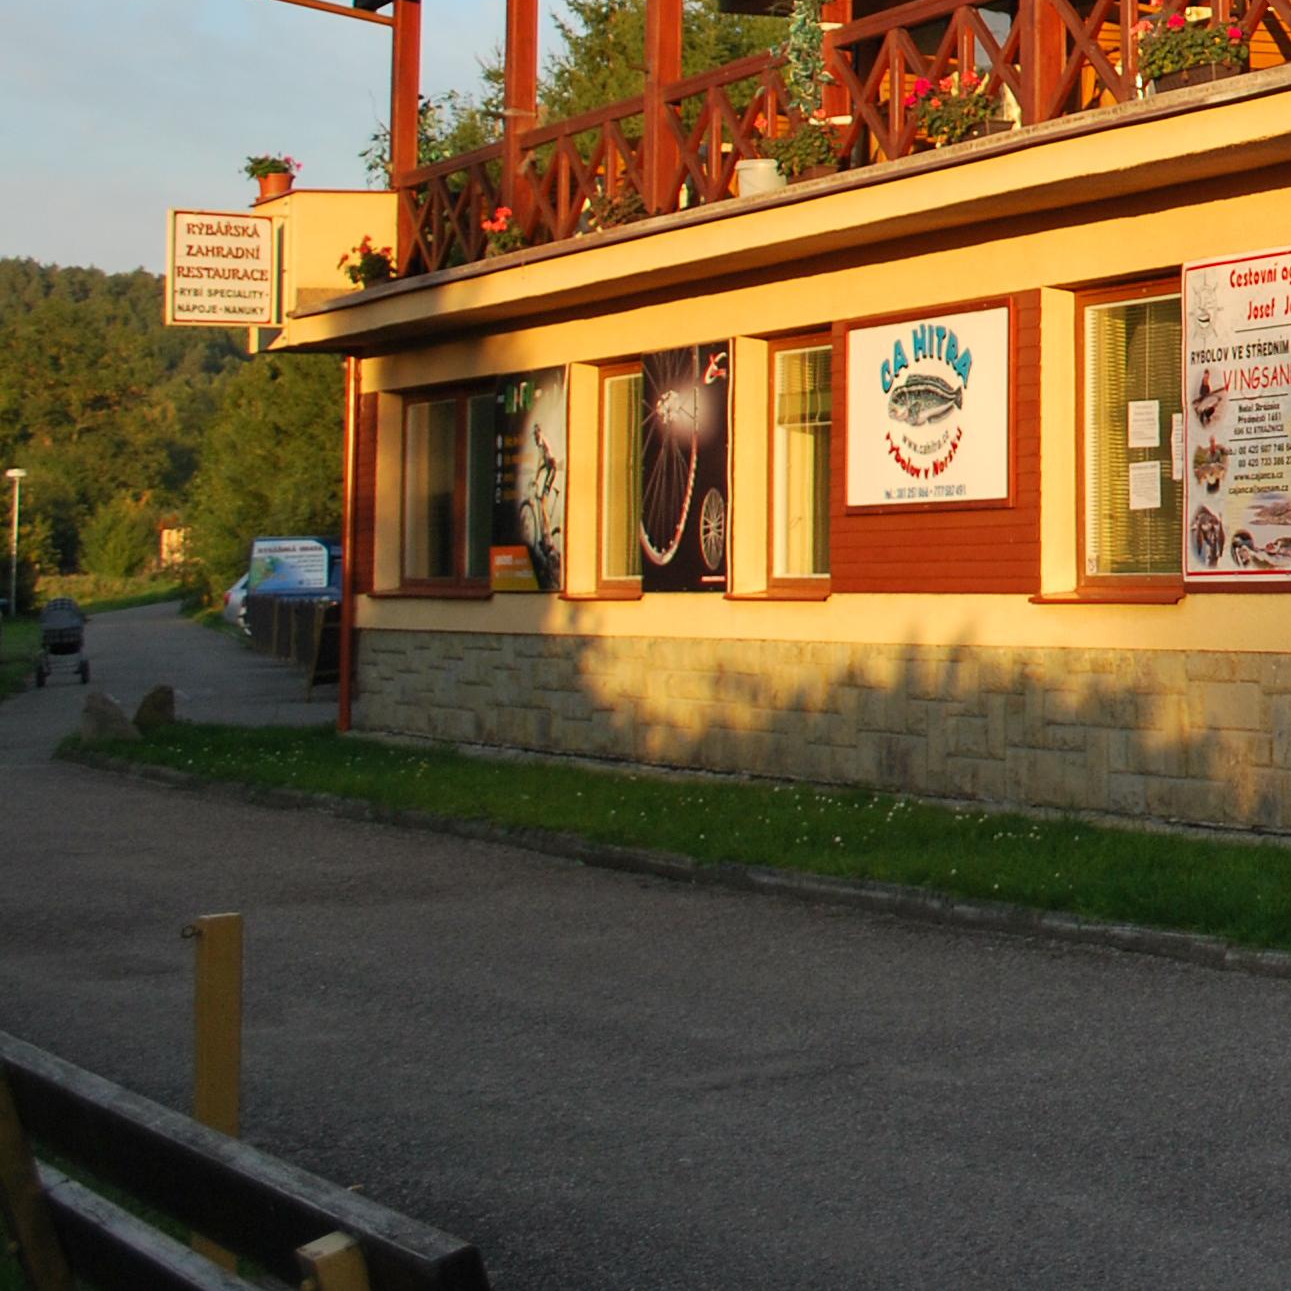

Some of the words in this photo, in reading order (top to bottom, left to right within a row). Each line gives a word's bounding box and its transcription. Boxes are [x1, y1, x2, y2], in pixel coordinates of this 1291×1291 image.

[186, 244, 260, 260] ZAHRADNÍ
[176, 266, 268, 281] RESTAURACE
[1229, 262, 1277, 288] Cestovní
[1247, 297, 1275, 321] Josef
[880, 339, 909, 394] CA
[912, 323, 972, 390] HITRA
[1190, 347, 1229, 366] RYBOLOV
[1231, 344, 1243, 360] VE
[1245, 335, 1290, 359] STŘEDNÍM
